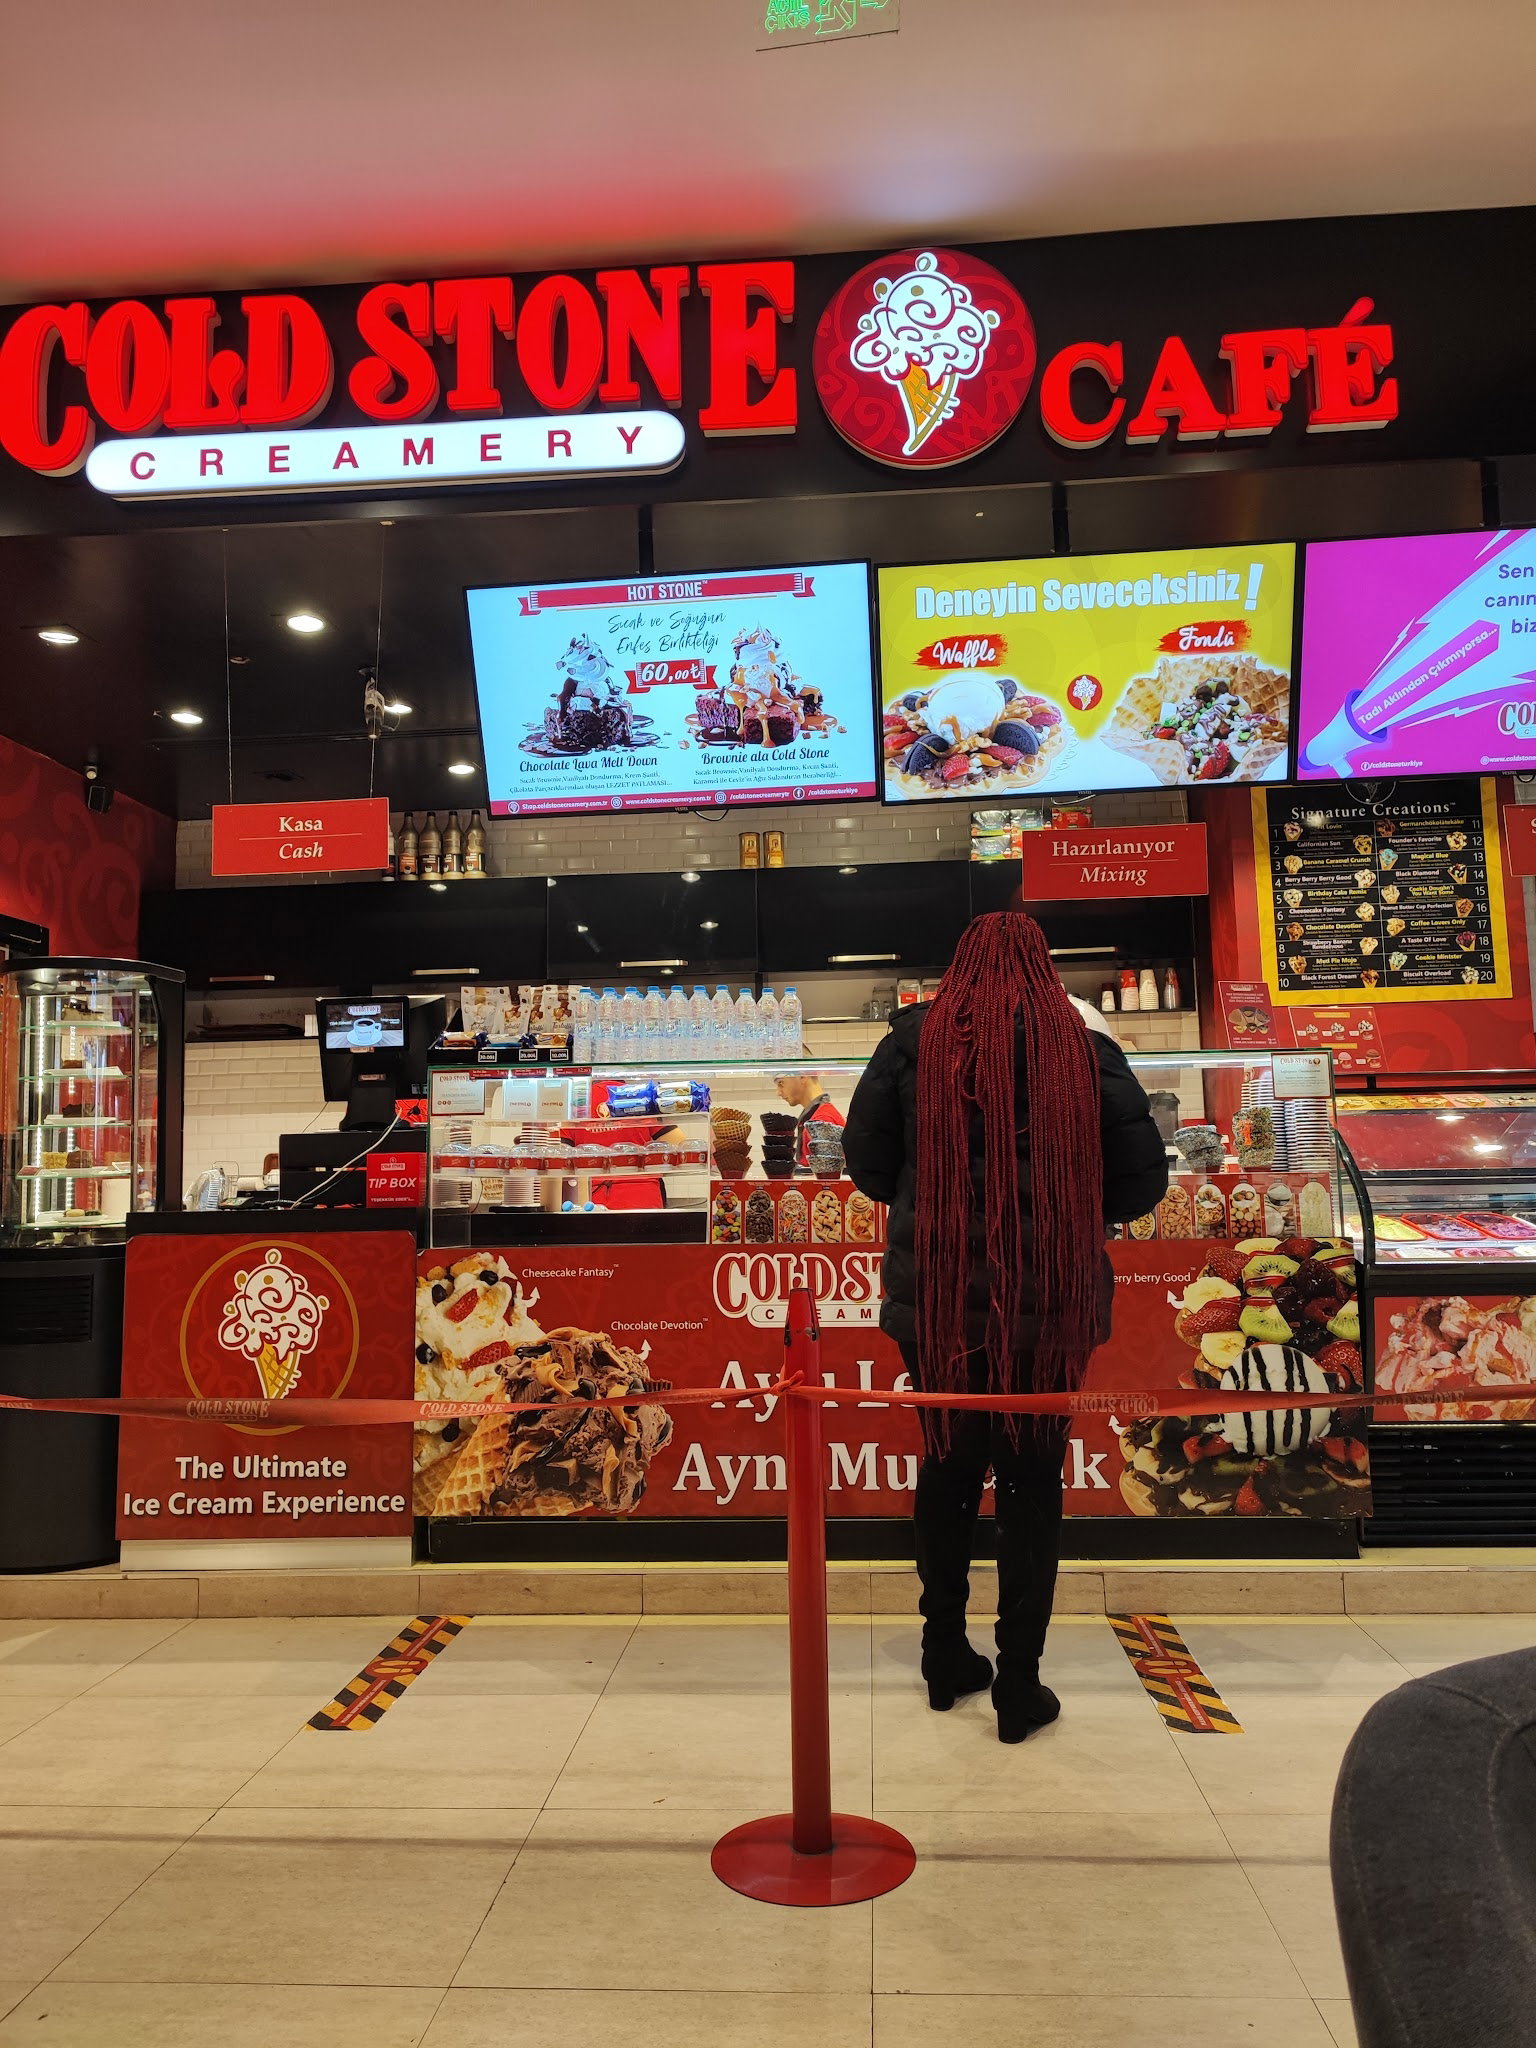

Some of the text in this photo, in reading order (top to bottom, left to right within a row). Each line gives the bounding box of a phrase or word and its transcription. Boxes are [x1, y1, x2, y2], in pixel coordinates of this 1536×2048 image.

[0, 261, 798, 475] COLD STONE
[1040, 296, 1399, 449] CAFÉ
[130, 425, 645, 481] CREAMERY
[627, 585, 654, 600] HOT
[915, 581, 1036, 618] Deneyin
[933, 640, 996, 668] Waffle
[701, 748, 830, 764] Brownie ala Cold Stone
[519, 755, 657, 772] Chocolate Lava Melt Down
[1291, 806, 1366, 821] Signature
[278, 816, 323, 833] Kasa
[1472, 820, 1480, 829] 11
[1472, 837, 1482, 846] 12
[279, 842, 323, 859] Cash
[1052, 839, 1175, 859] Hazırlanıyor
[1473, 852, 1483, 861] 13
[1275, 862, 1281, 870] 3
[1079, 866, 1148, 886] Mixing
[1474, 870, 1484, 879] 14
[1275, 878, 1281, 887] 4
[1475, 887, 1485, 896] 15
[1276, 895, 1282, 904] 5
[1476, 903, 1487, 912] 16
[1277, 911, 1283, 920] 6
[1477, 920, 1487, 929] 17
[1278, 928, 1284, 936] 7
[1479, 936, 1489, 945] 18
[1279, 944, 1285, 953] 8
[1480, 953, 1490, 963] 19
[1279, 961, 1286, 970] 9
[1481, 971, 1492, 980] 20
[1279, 978, 1289, 988] 10
[369, 1177, 417, 1188] TIP BOX
[522, 1268, 576, 1278] Cheesecake
[1134, 1272, 1160, 1284] berry
[611, 1320, 658, 1330] Chocolate
[187, 1400, 270, 1418] COLD STONE
[420, 1402, 457, 1415] COLD
[175, 1455, 347, 1480] The Ultimate
[124, 1489, 405, 1520] Ice Cream Experience
